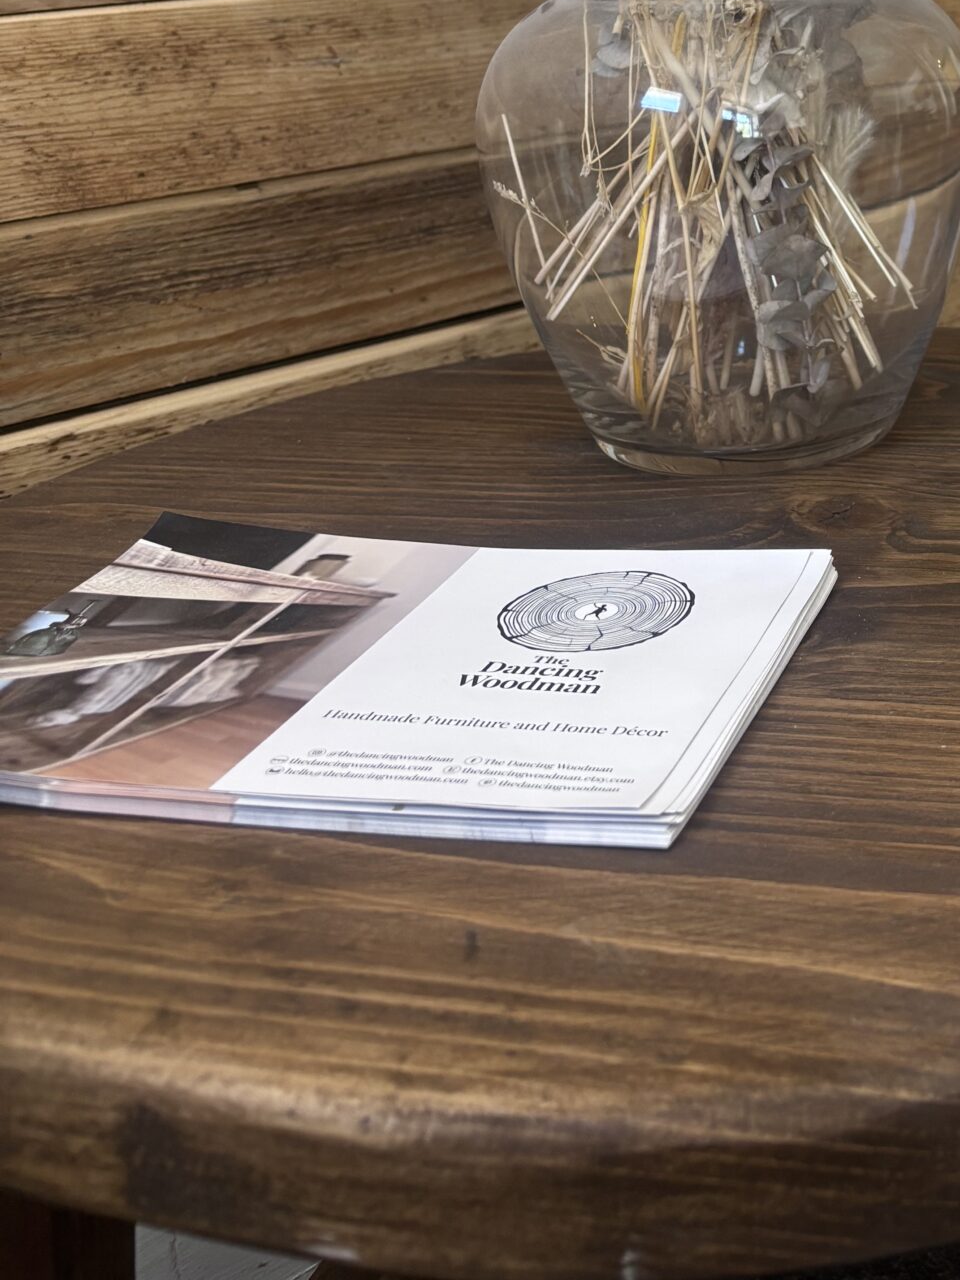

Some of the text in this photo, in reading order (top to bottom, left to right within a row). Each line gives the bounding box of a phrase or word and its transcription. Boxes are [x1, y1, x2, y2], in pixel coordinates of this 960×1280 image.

[533, 655, 570, 665] The
[478, 661, 604, 682] Dancing
[459, 674, 601, 694] Woodman
[322, 709, 669, 738] Handmade Furniture and Home Décor
[483, 757, 614, 773] The Dancing Woodman
